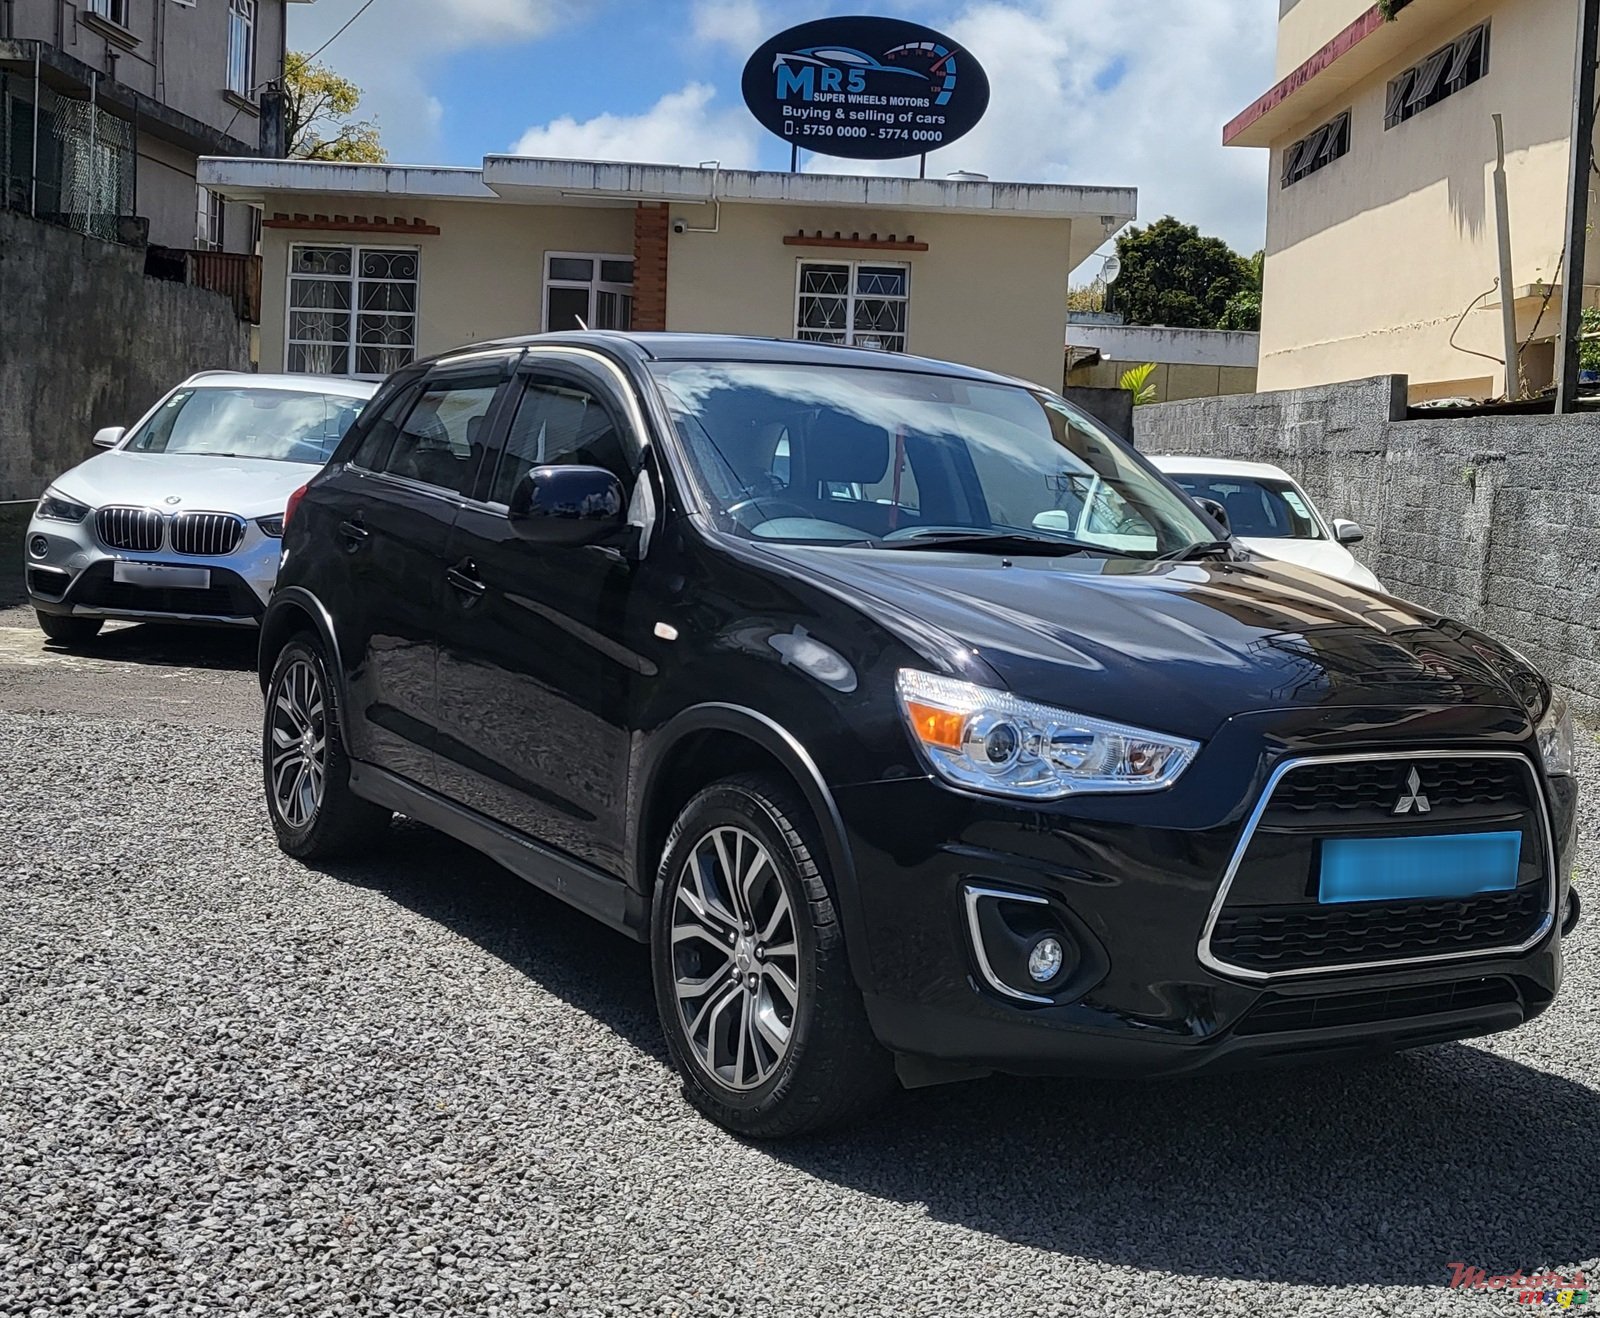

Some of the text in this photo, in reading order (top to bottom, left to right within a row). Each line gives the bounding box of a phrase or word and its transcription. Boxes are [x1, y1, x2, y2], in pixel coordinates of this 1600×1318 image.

[813, 92, 930, 108] SUPER WHEELS MOTORS
[782, 105, 946, 125] Buying & selling of cars
[802, 124, 834, 136] 5750
[836, 126, 867, 138] 0000
[878, 128, 909, 140] 5774
[912, 130, 943, 142] 0000
